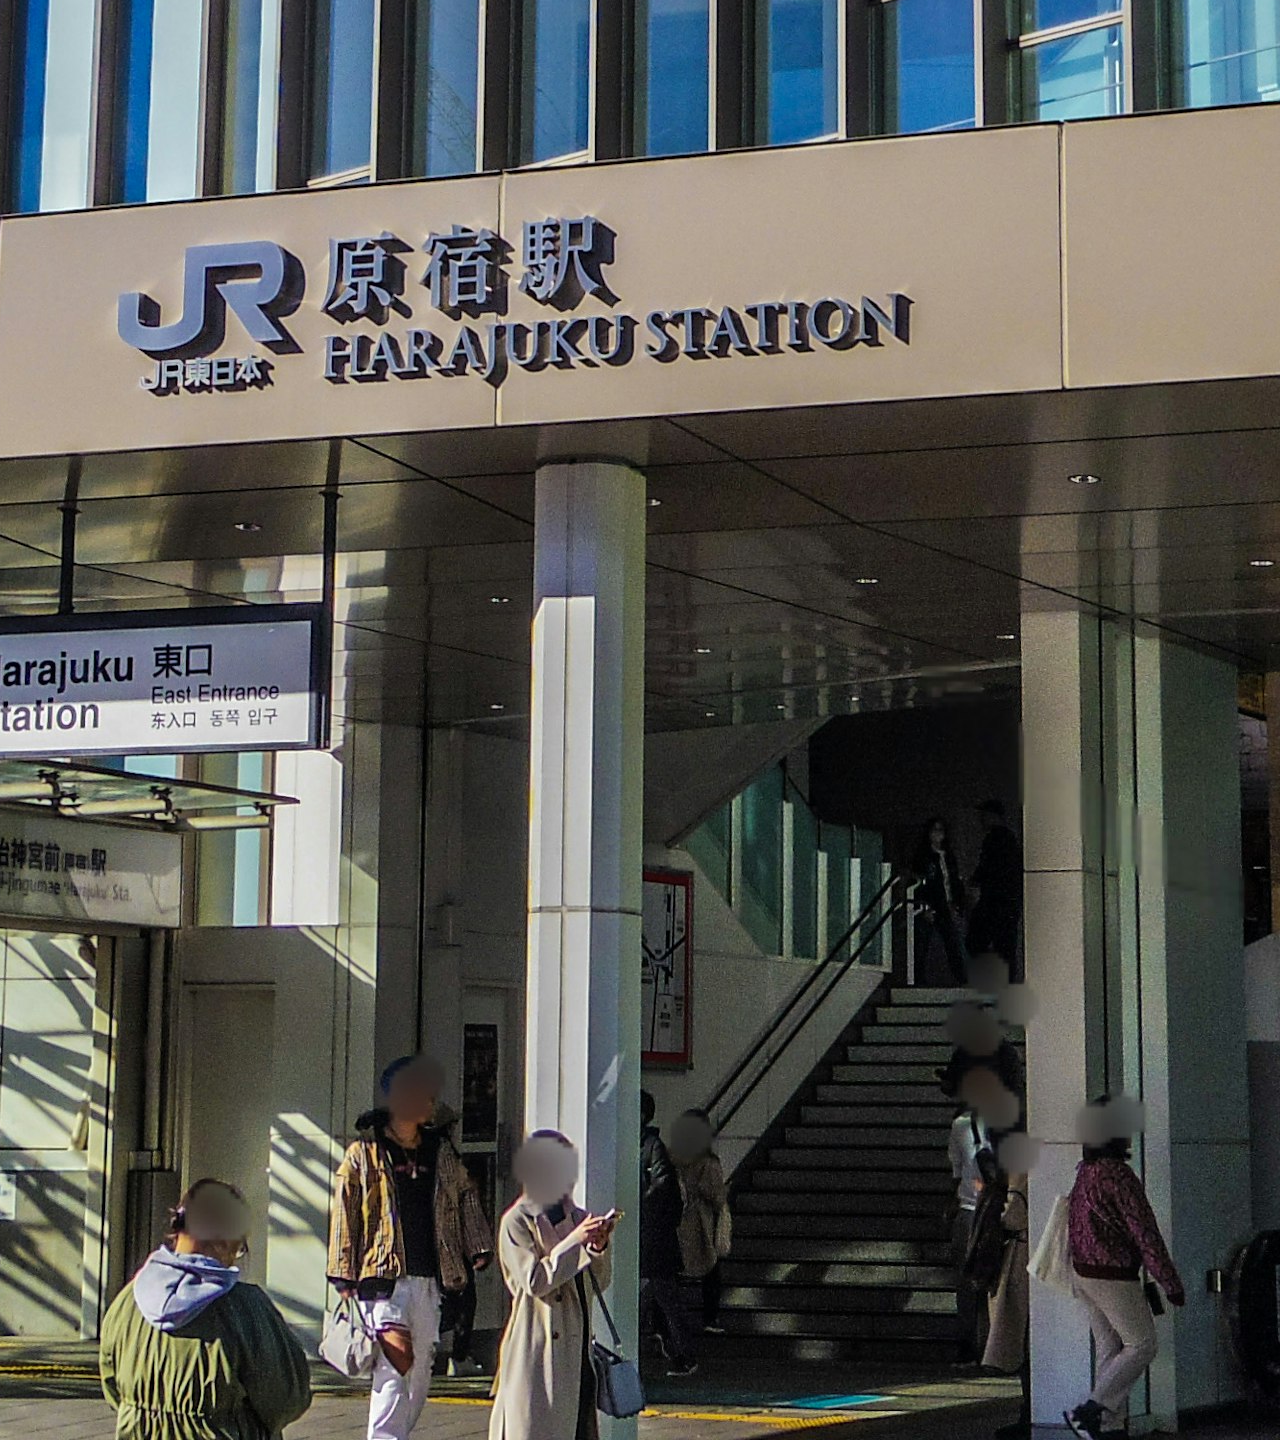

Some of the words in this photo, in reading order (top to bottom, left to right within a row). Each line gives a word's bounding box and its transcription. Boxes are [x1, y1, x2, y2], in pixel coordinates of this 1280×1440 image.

[322, 215, 602, 315] 原宿駅
[118, 240, 287, 352] JR
[323, 312, 630, 384] HARAJUKU
[644, 293, 908, 360] STATION
[139, 354, 266, 392] JR東日本
[152, 643, 213, 679] 東口
[151, 685, 192, 704] East
[198, 683, 280, 703] Entrance
[151, 712, 197, 730] 东入口
[210, 709, 240, 727] 동쪽
[248, 708, 279, 726] 입구
